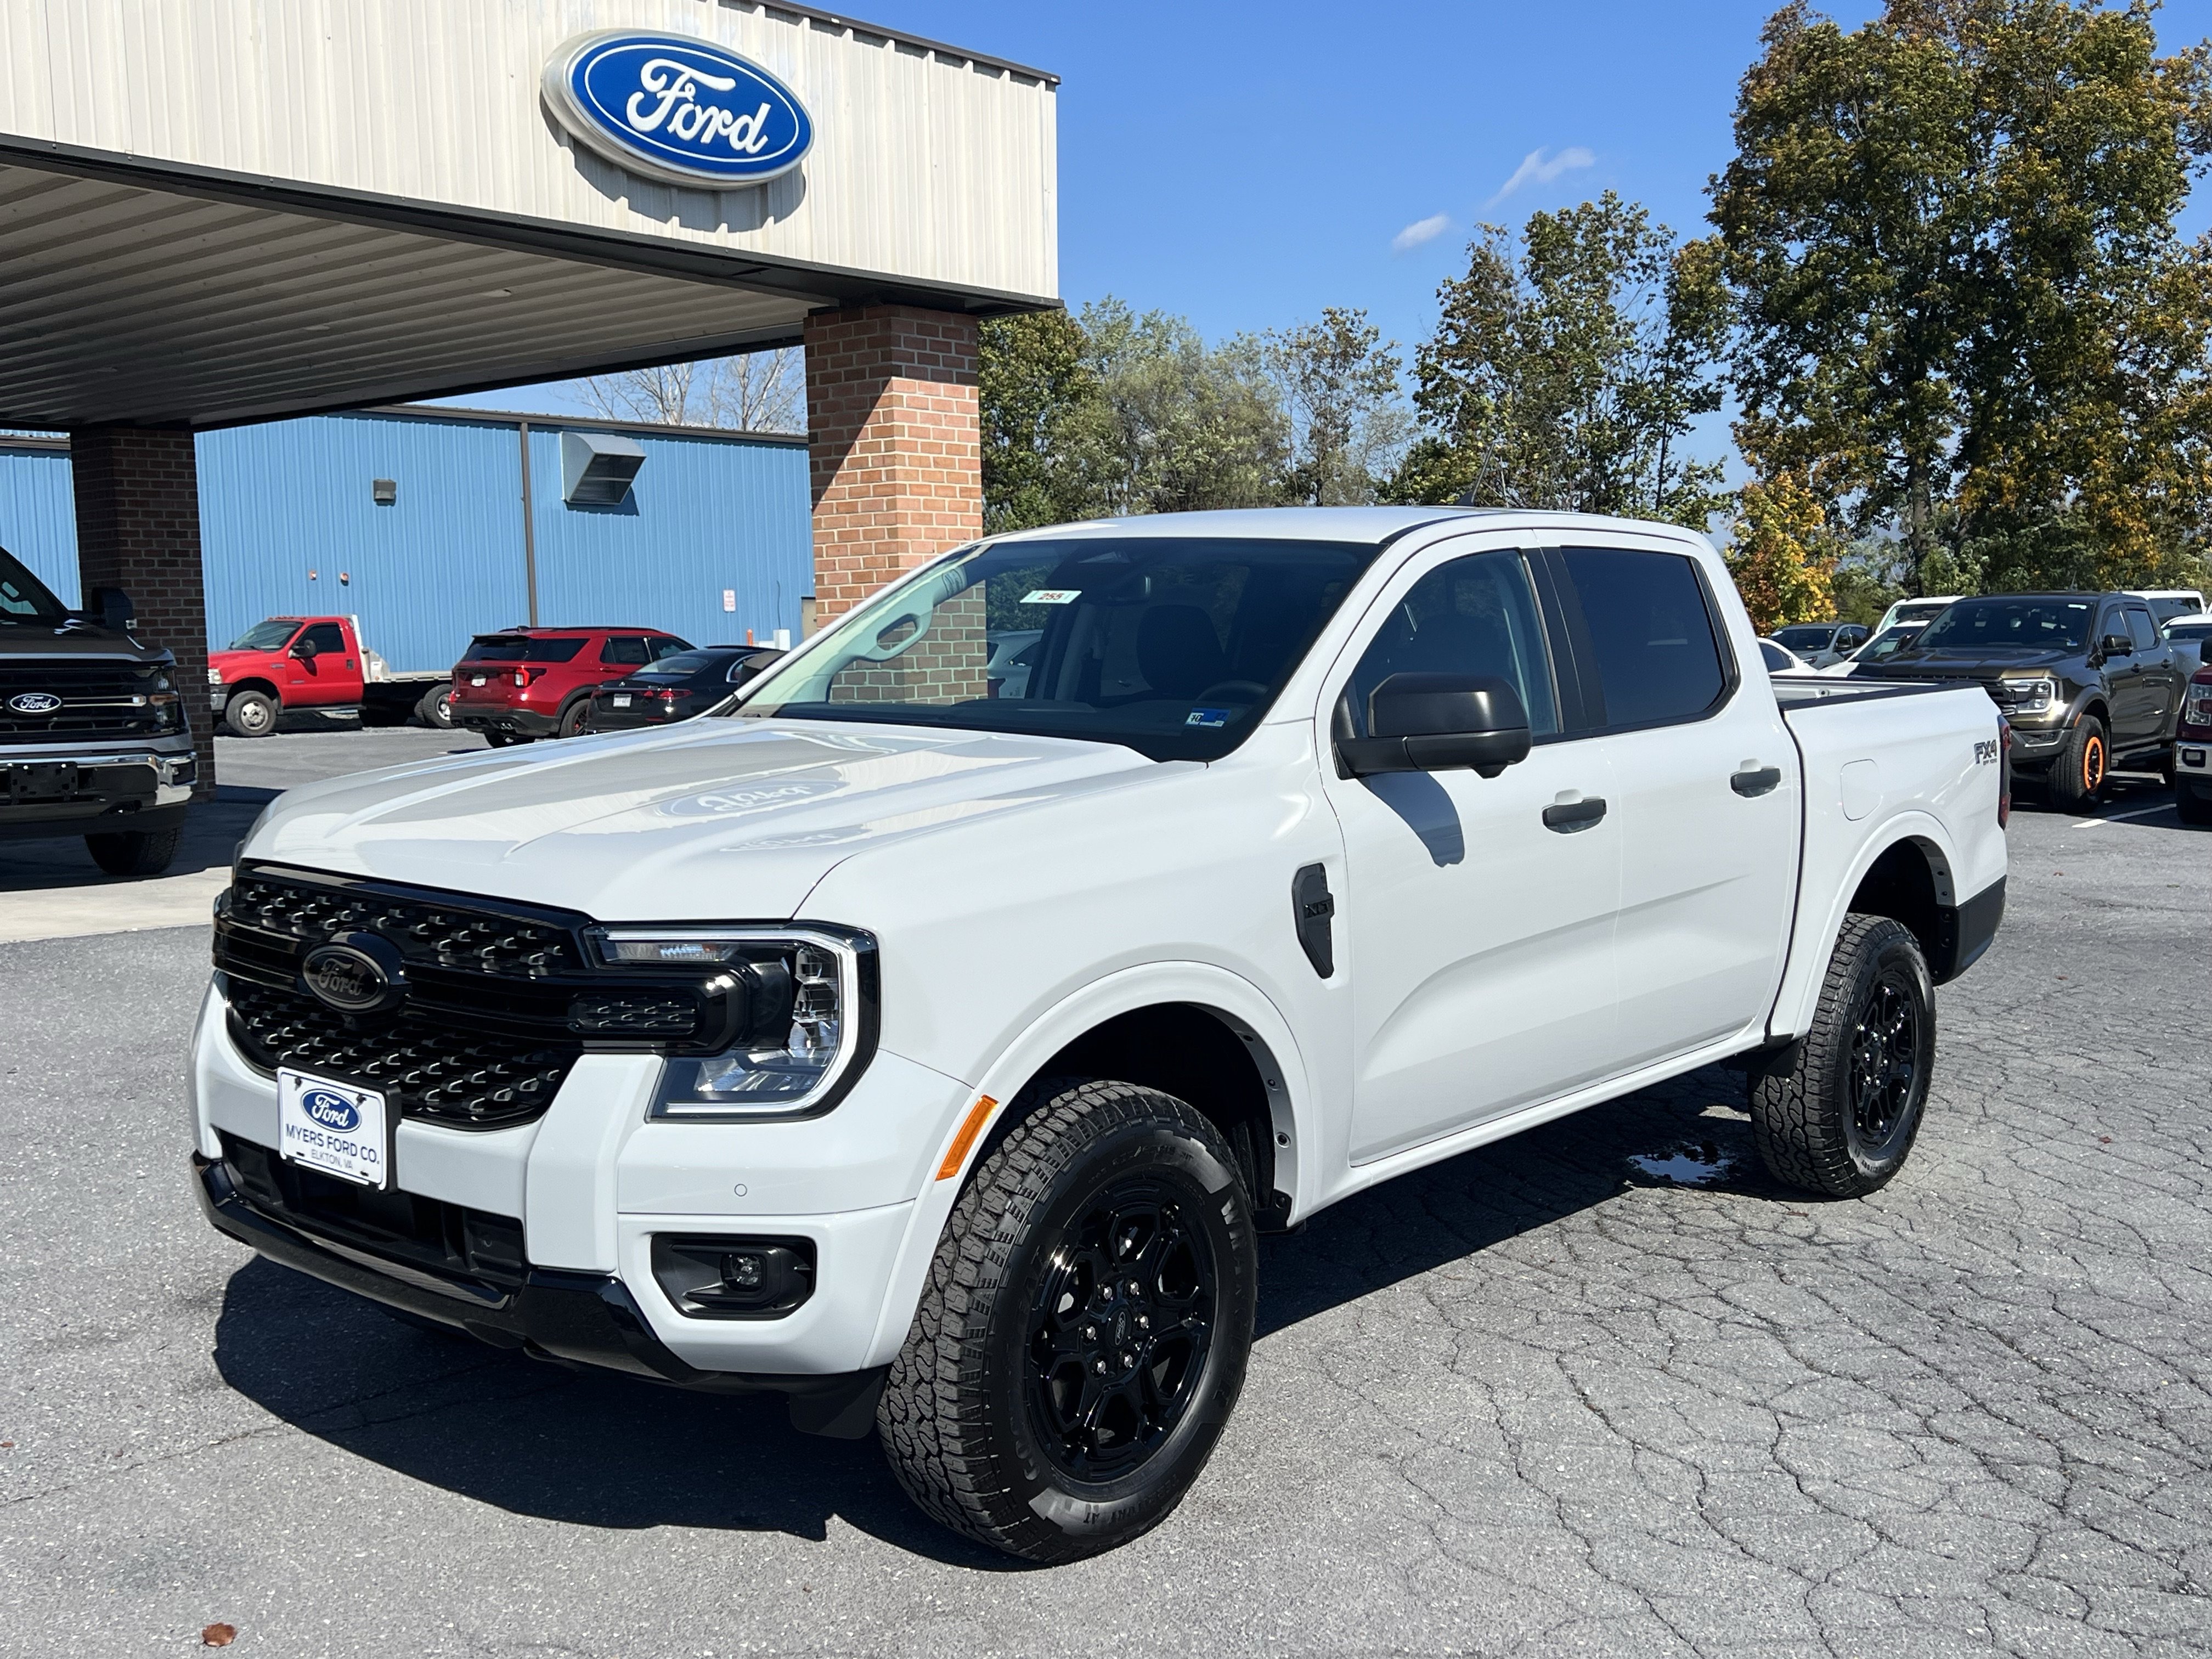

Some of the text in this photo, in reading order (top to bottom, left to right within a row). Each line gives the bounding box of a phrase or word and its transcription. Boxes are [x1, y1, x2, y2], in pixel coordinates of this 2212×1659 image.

[627, 58, 771, 154] Ford
[1037, 592, 1064, 601] 255
[20, 696, 52, 708] Ford
[1974, 739, 1997, 764] FX4
[318, 957, 365, 996] Ford
[312, 1094, 349, 1127] Ford
[285, 1123, 380, 1165] MYERS FORD CO.
[311, 1148, 353, 1169] ELKTON, VA
